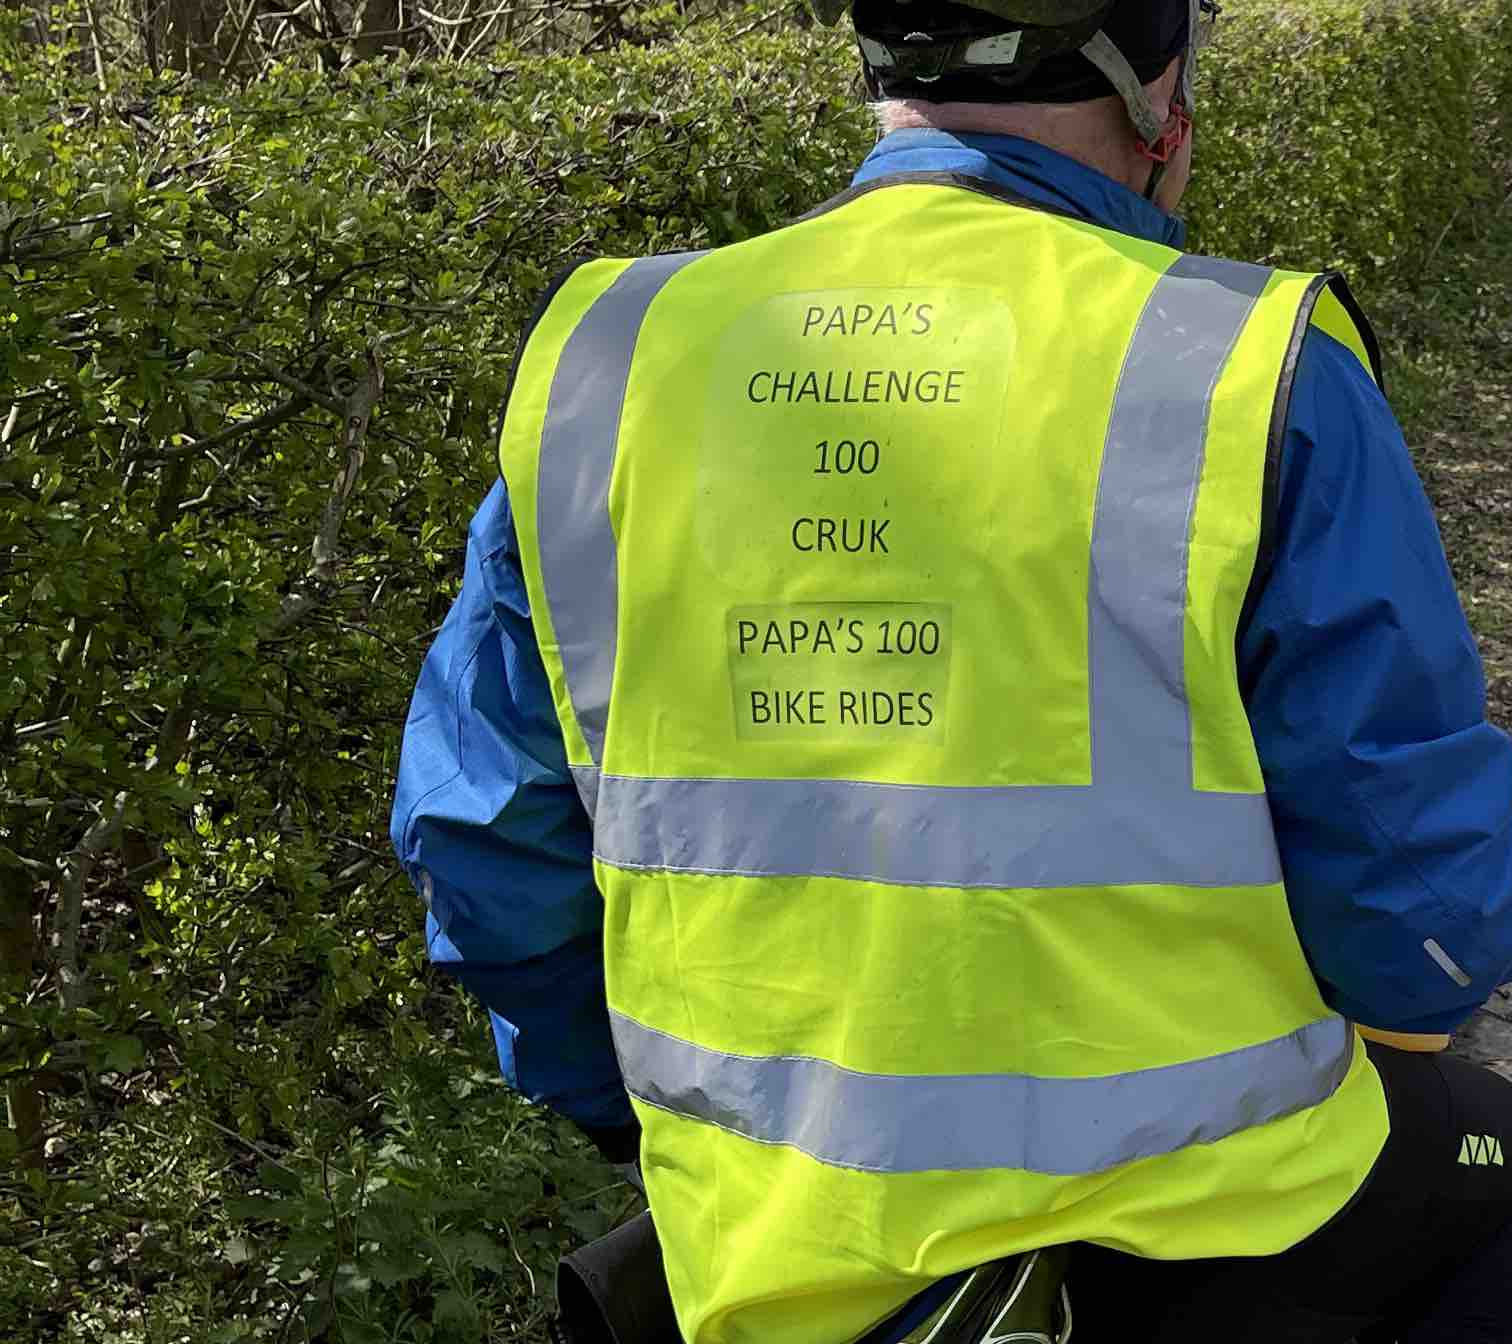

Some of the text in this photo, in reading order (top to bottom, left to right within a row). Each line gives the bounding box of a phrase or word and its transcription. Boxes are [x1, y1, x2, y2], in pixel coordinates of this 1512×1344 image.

[802, 302, 932, 337] PAPA'S
[748, 370, 965, 404] CHALLENGE
[813, 440, 880, 474] 100
[792, 518, 890, 553] CRUK
[737, 619, 940, 654] PAPA'S 100
[750, 691, 933, 727] BIKE RIDES
